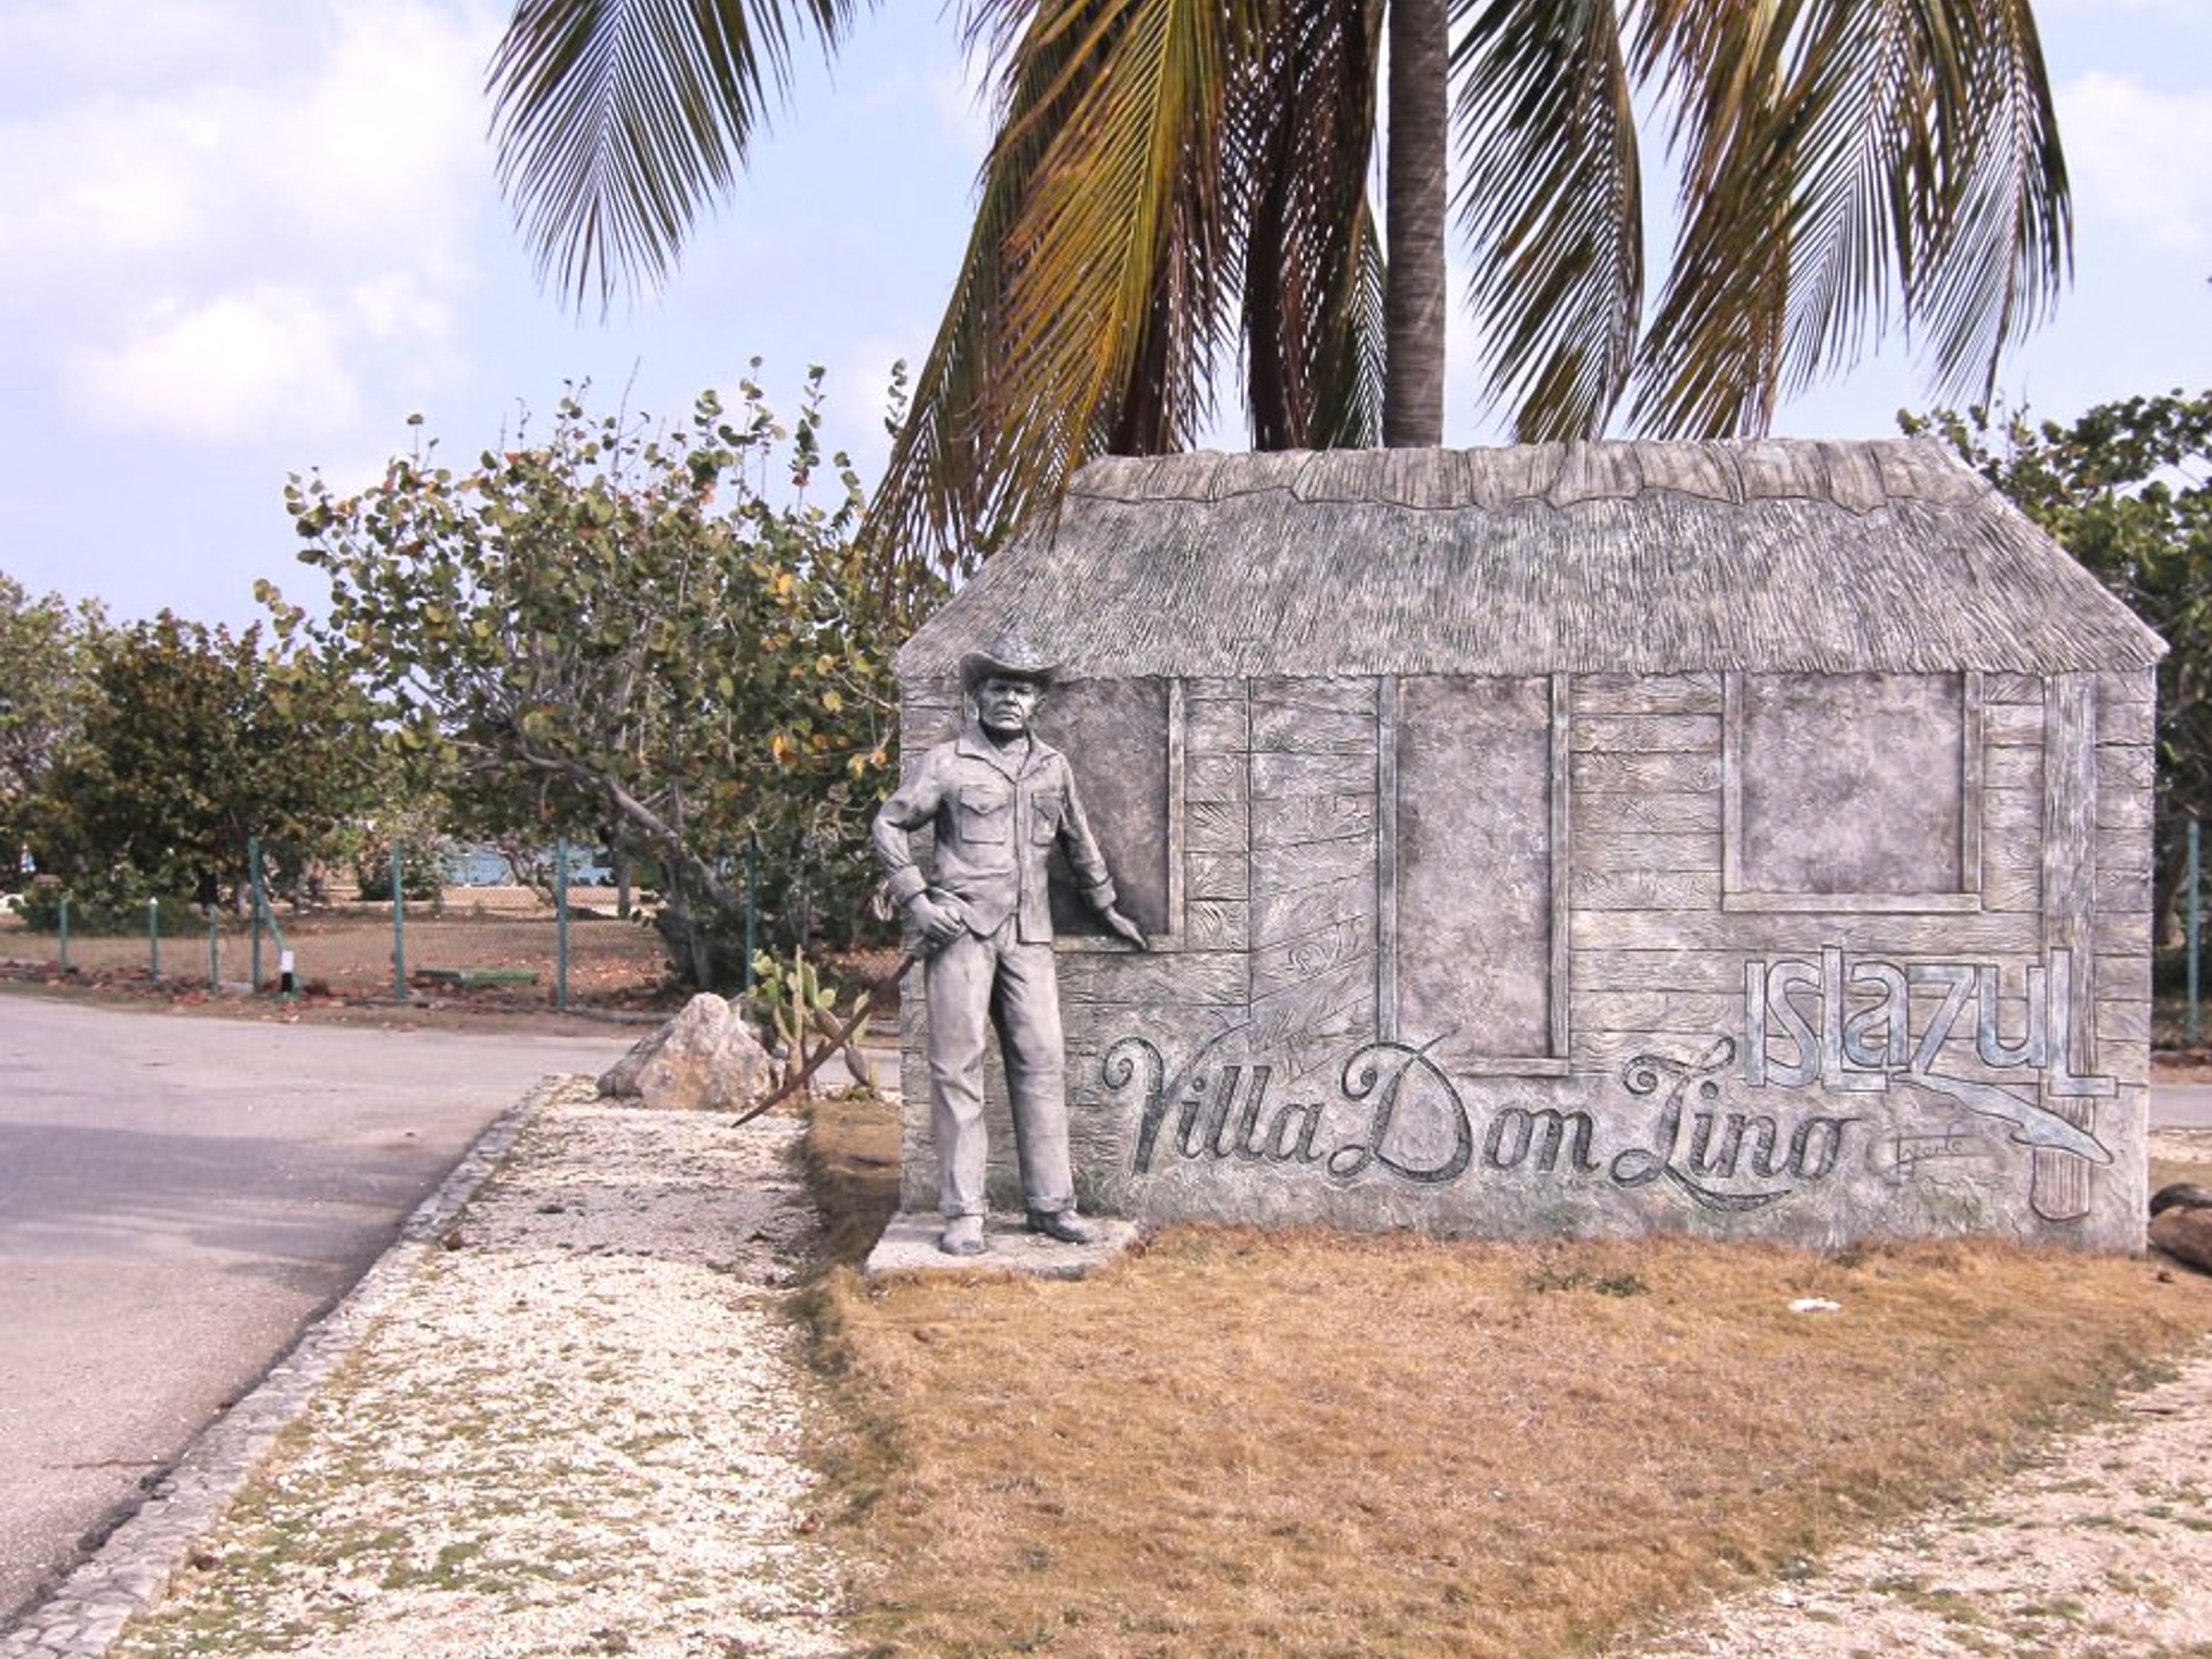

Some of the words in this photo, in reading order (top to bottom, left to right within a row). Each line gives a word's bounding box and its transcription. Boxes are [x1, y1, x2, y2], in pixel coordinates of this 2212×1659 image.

[1103, 1022, 1330, 1175] Villa
[1327, 1029, 1600, 1183] Don
[1610, 1036, 1861, 1211] Lino
